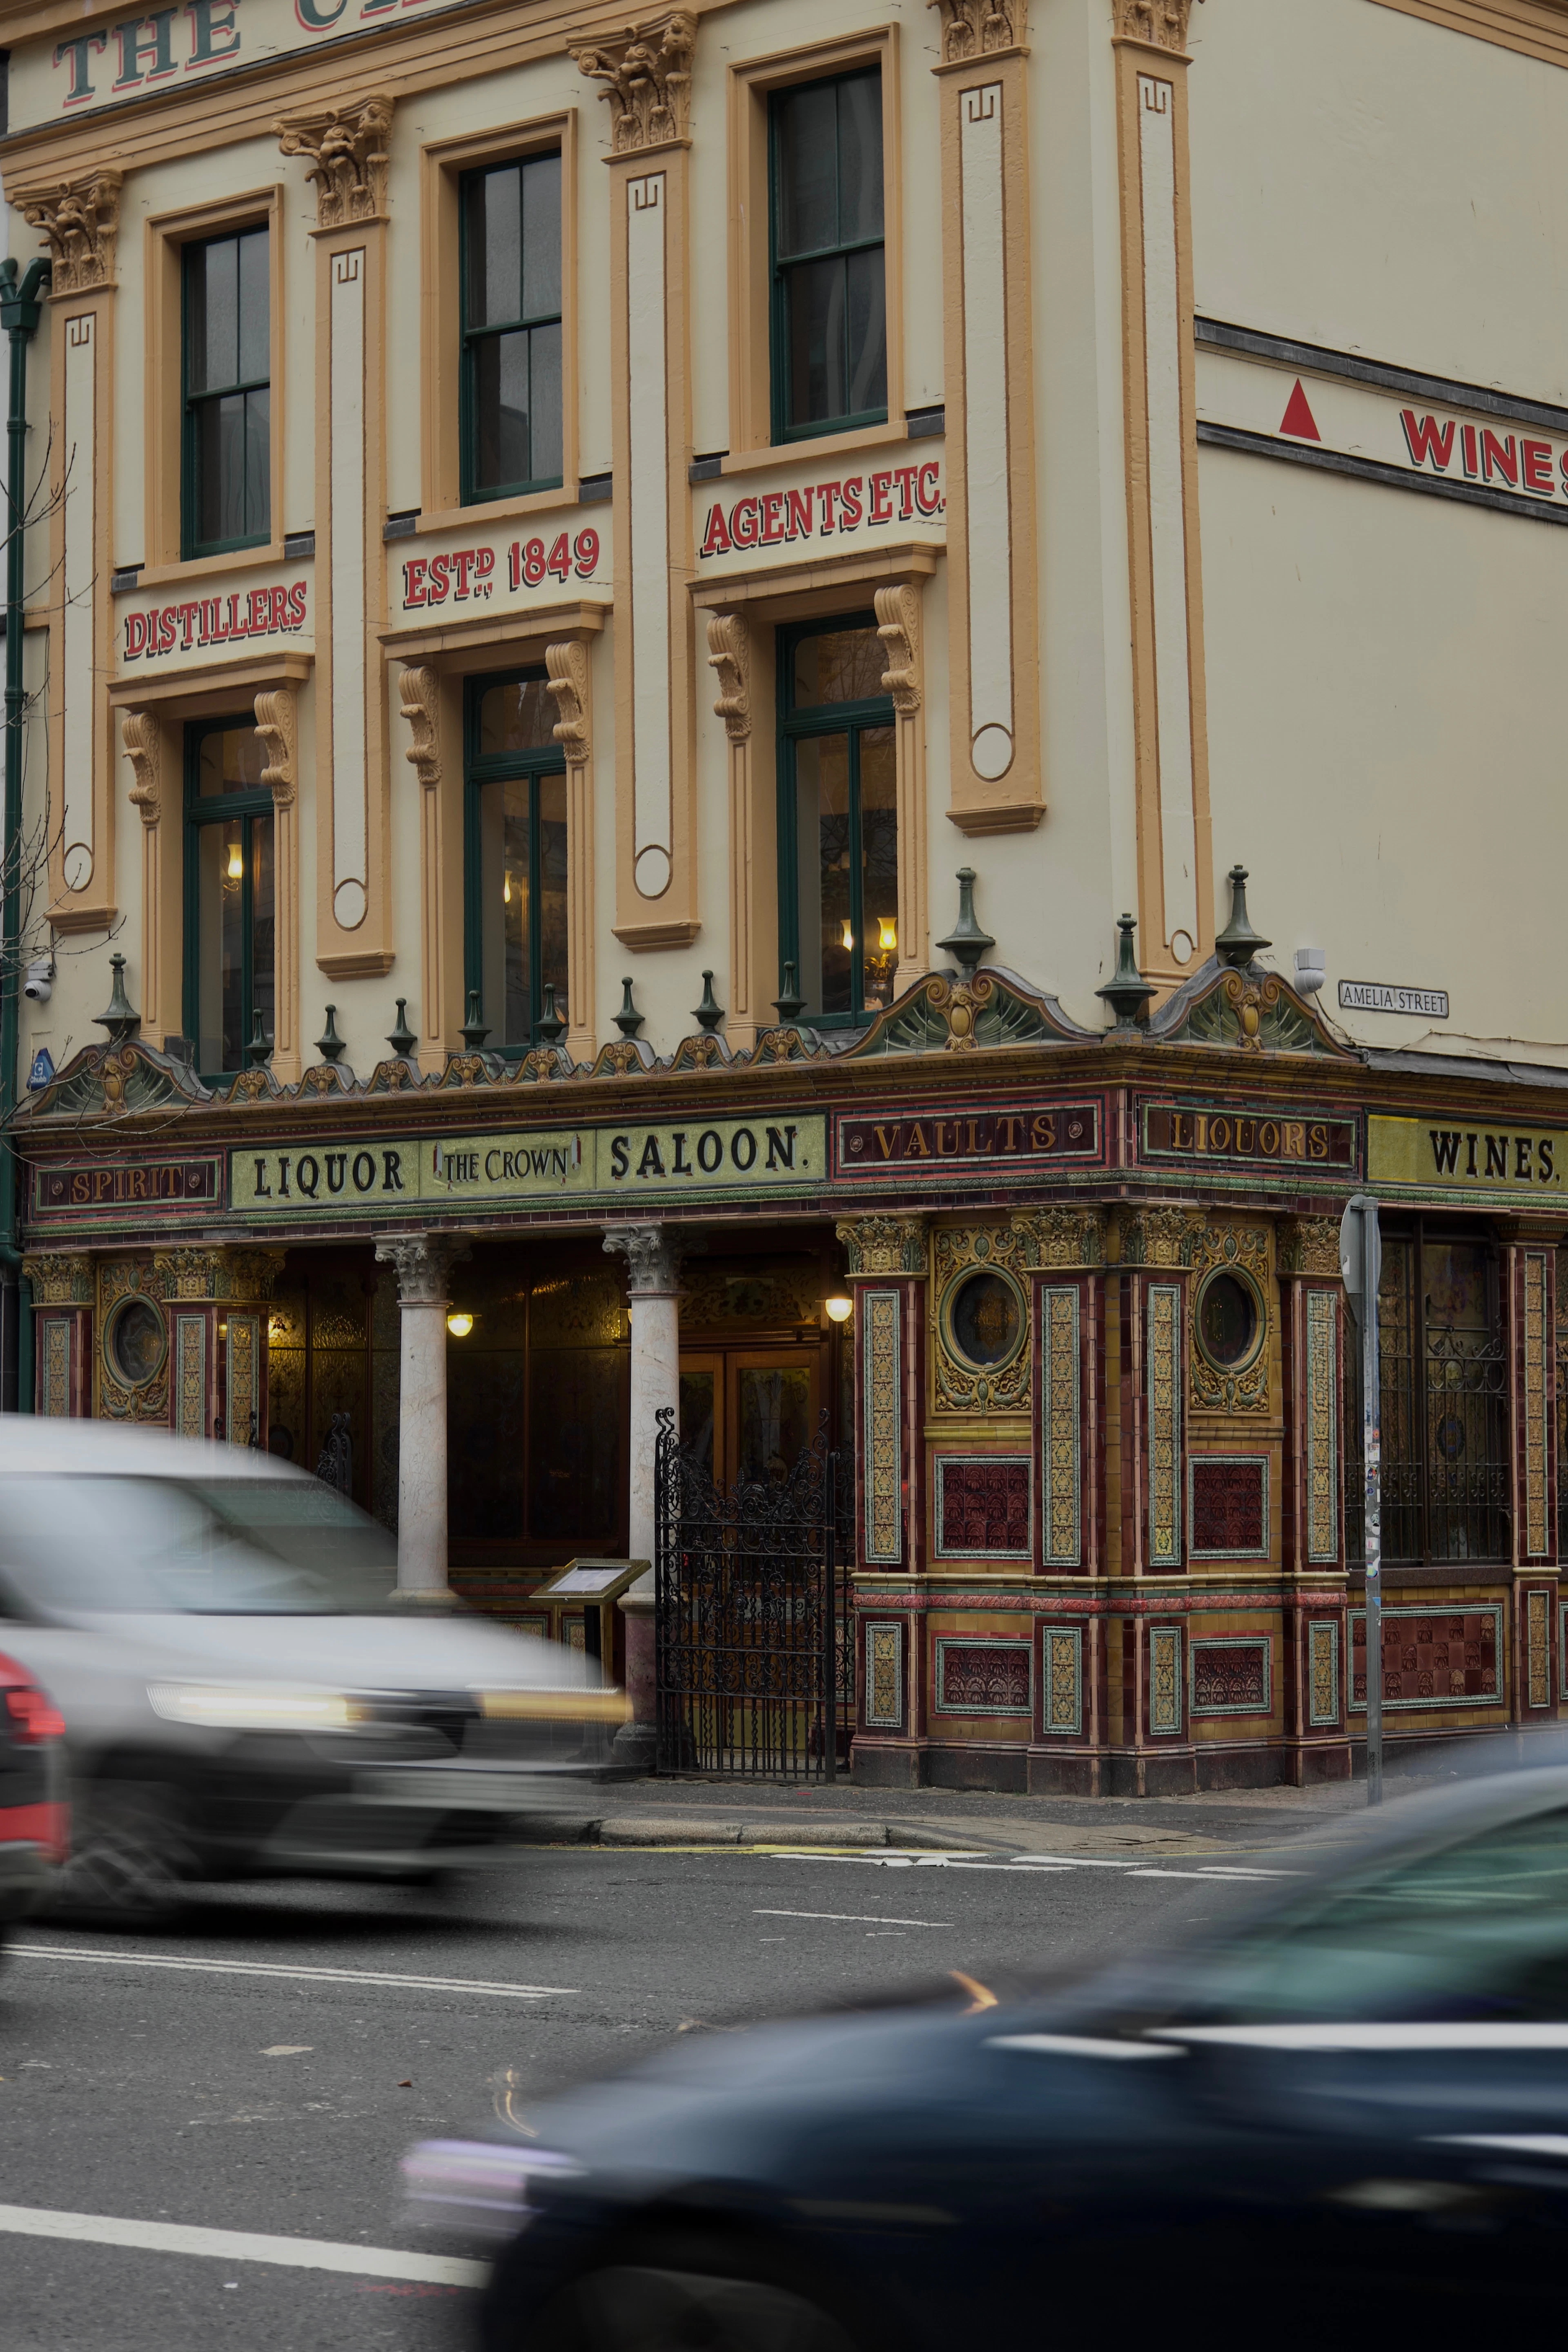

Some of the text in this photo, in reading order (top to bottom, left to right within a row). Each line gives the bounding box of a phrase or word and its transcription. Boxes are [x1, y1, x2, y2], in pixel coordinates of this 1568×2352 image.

[53, 0, 241, 108] THE
[700, 461, 947, 559] AGENTS ETC.
[508, 528, 599, 592] 1849
[124, 581, 307, 662] DISTILLERS
[1343, 986, 1445, 1012] AMELIA STREET
[30, 1076, 47, 1084] Chubb
[611, 1126, 809, 1180] SALOON.
[874, 1115, 1056, 1159] VAULTS
[1172, 1114, 1328, 1158] LIQUORS
[1429, 1130, 1561, 1185] WINES,
[72, 1166, 183, 1203] SPIRIT
[254, 1151, 405, 1200] LIQUOR
[444, 1148, 568, 1183] THE CROWN
